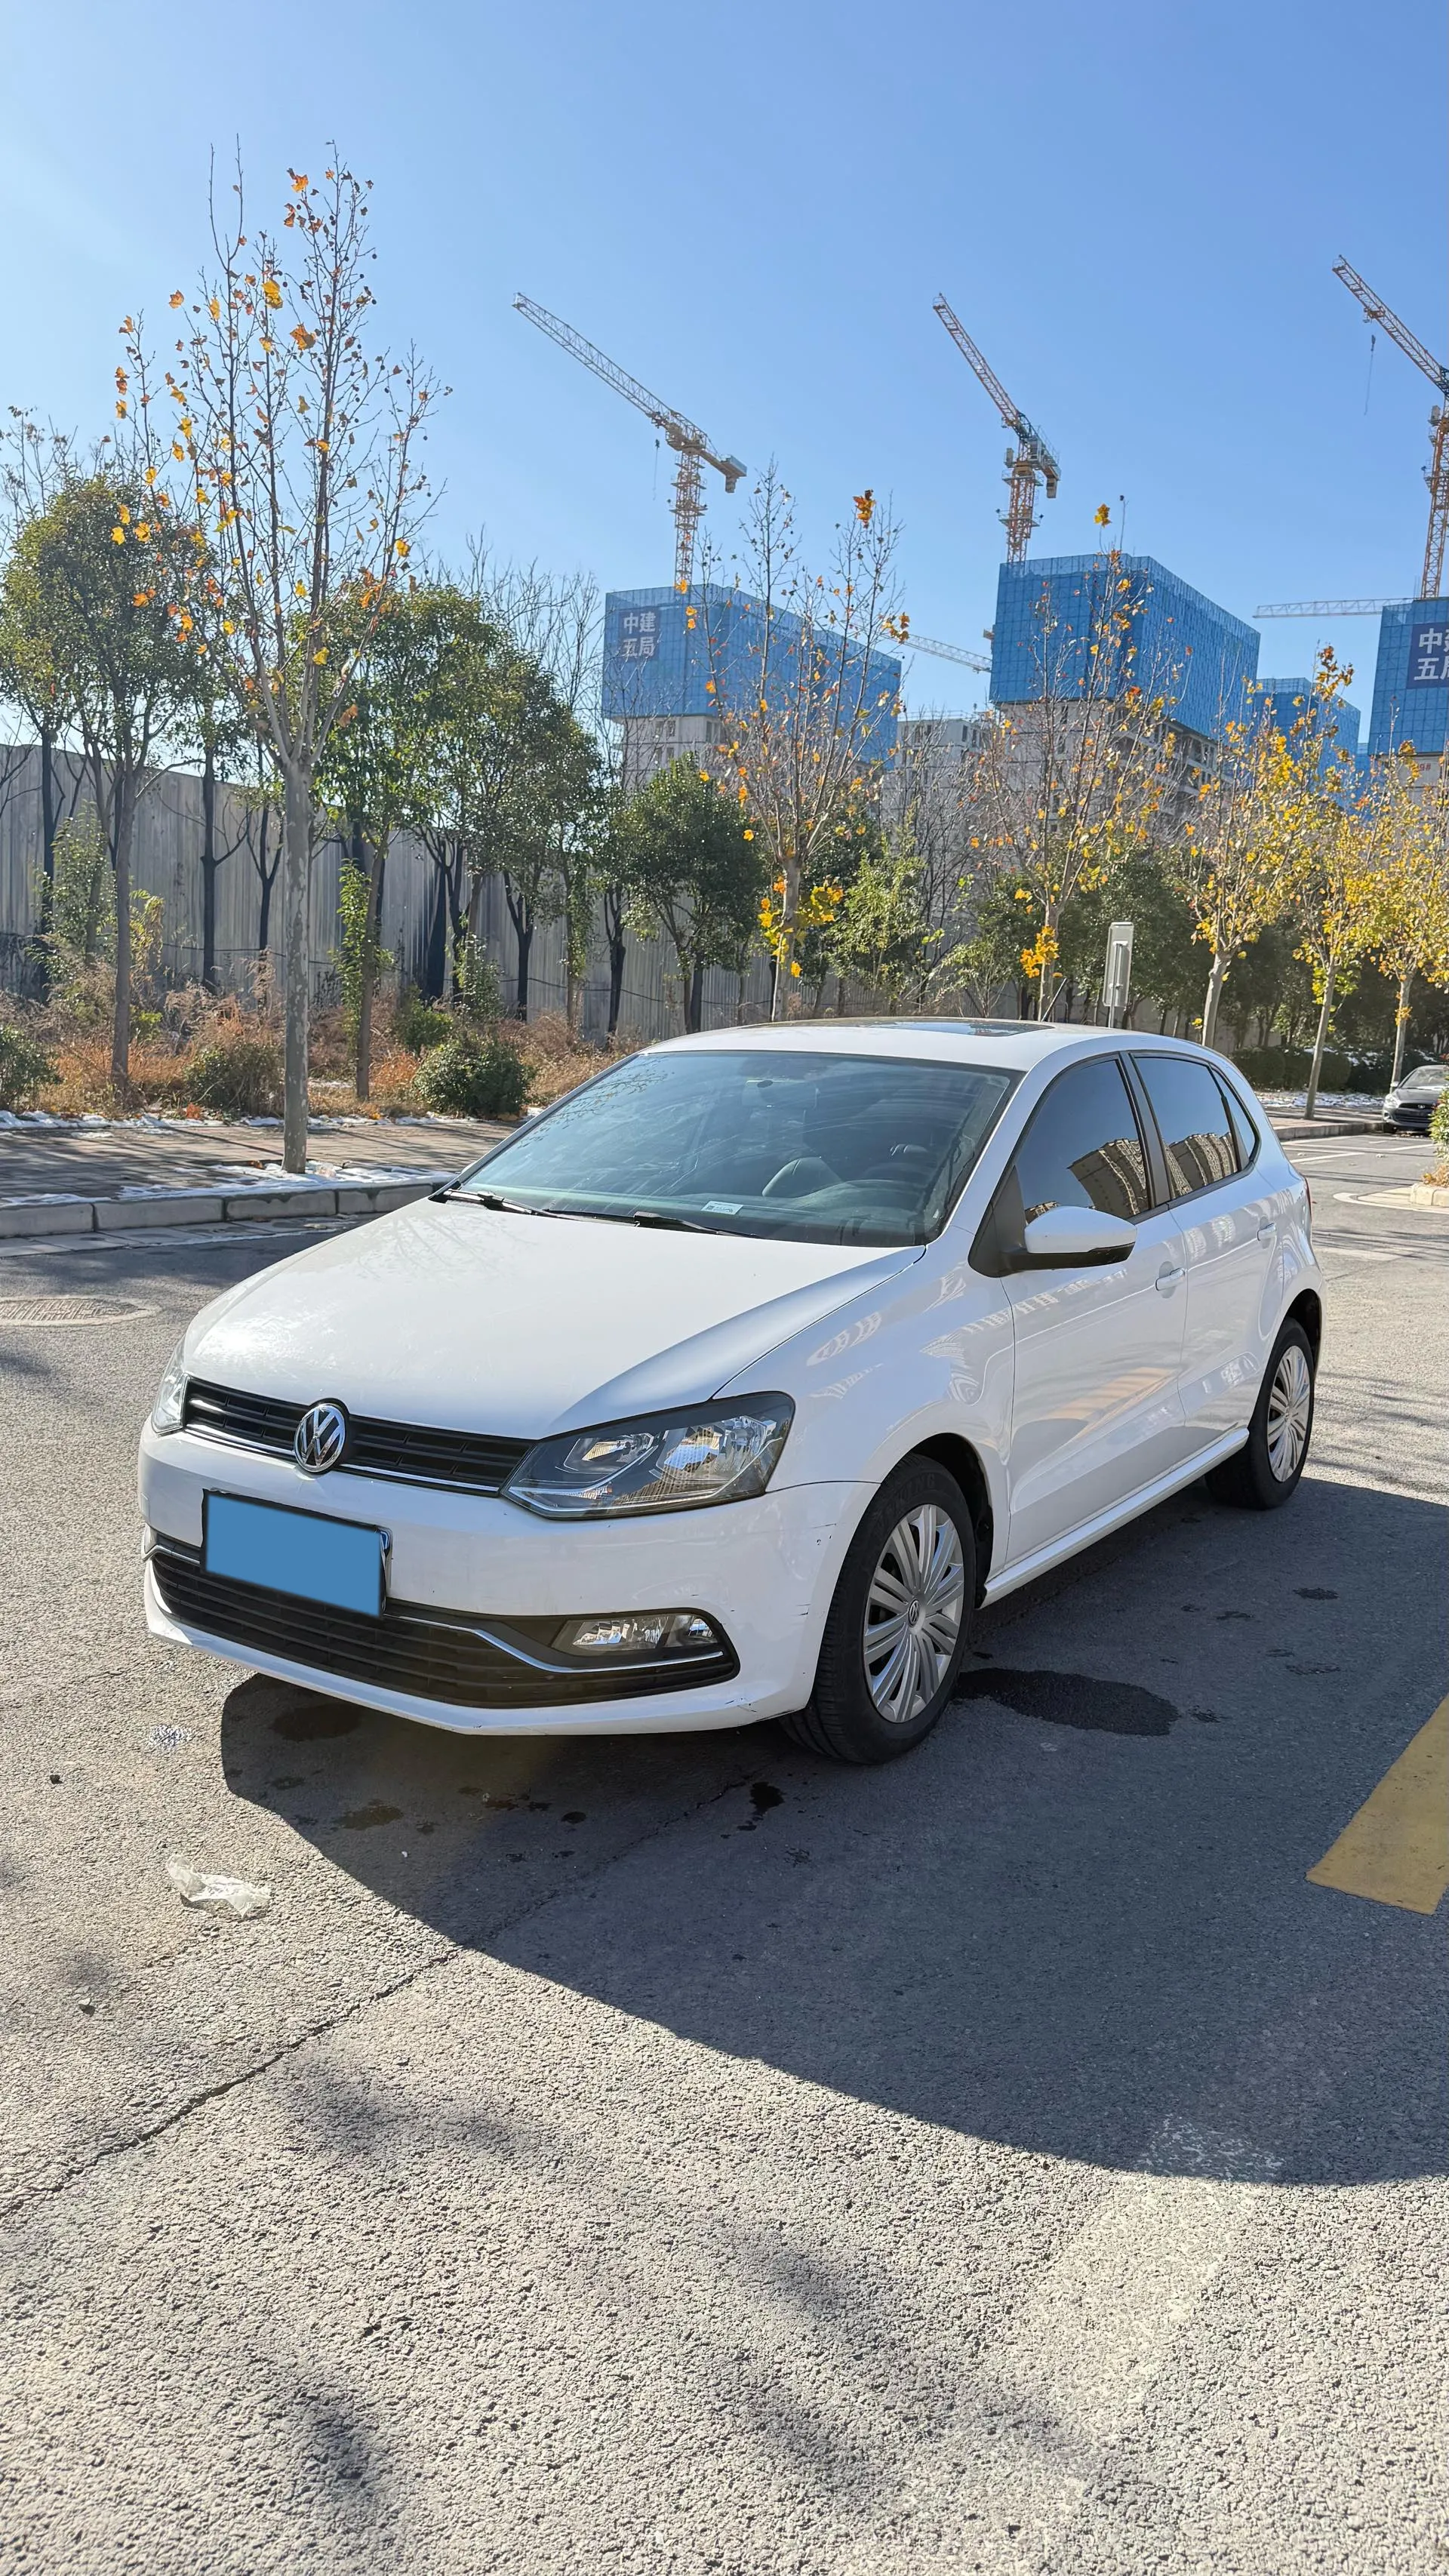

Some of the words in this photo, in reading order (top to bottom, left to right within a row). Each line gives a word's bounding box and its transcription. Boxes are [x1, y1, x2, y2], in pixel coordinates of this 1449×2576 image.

[623, 611, 656, 634] 中建
[622, 636, 655, 657] 五局
[1419, 628, 1449, 654] 中
[297, 1405, 344, 1470] VW
